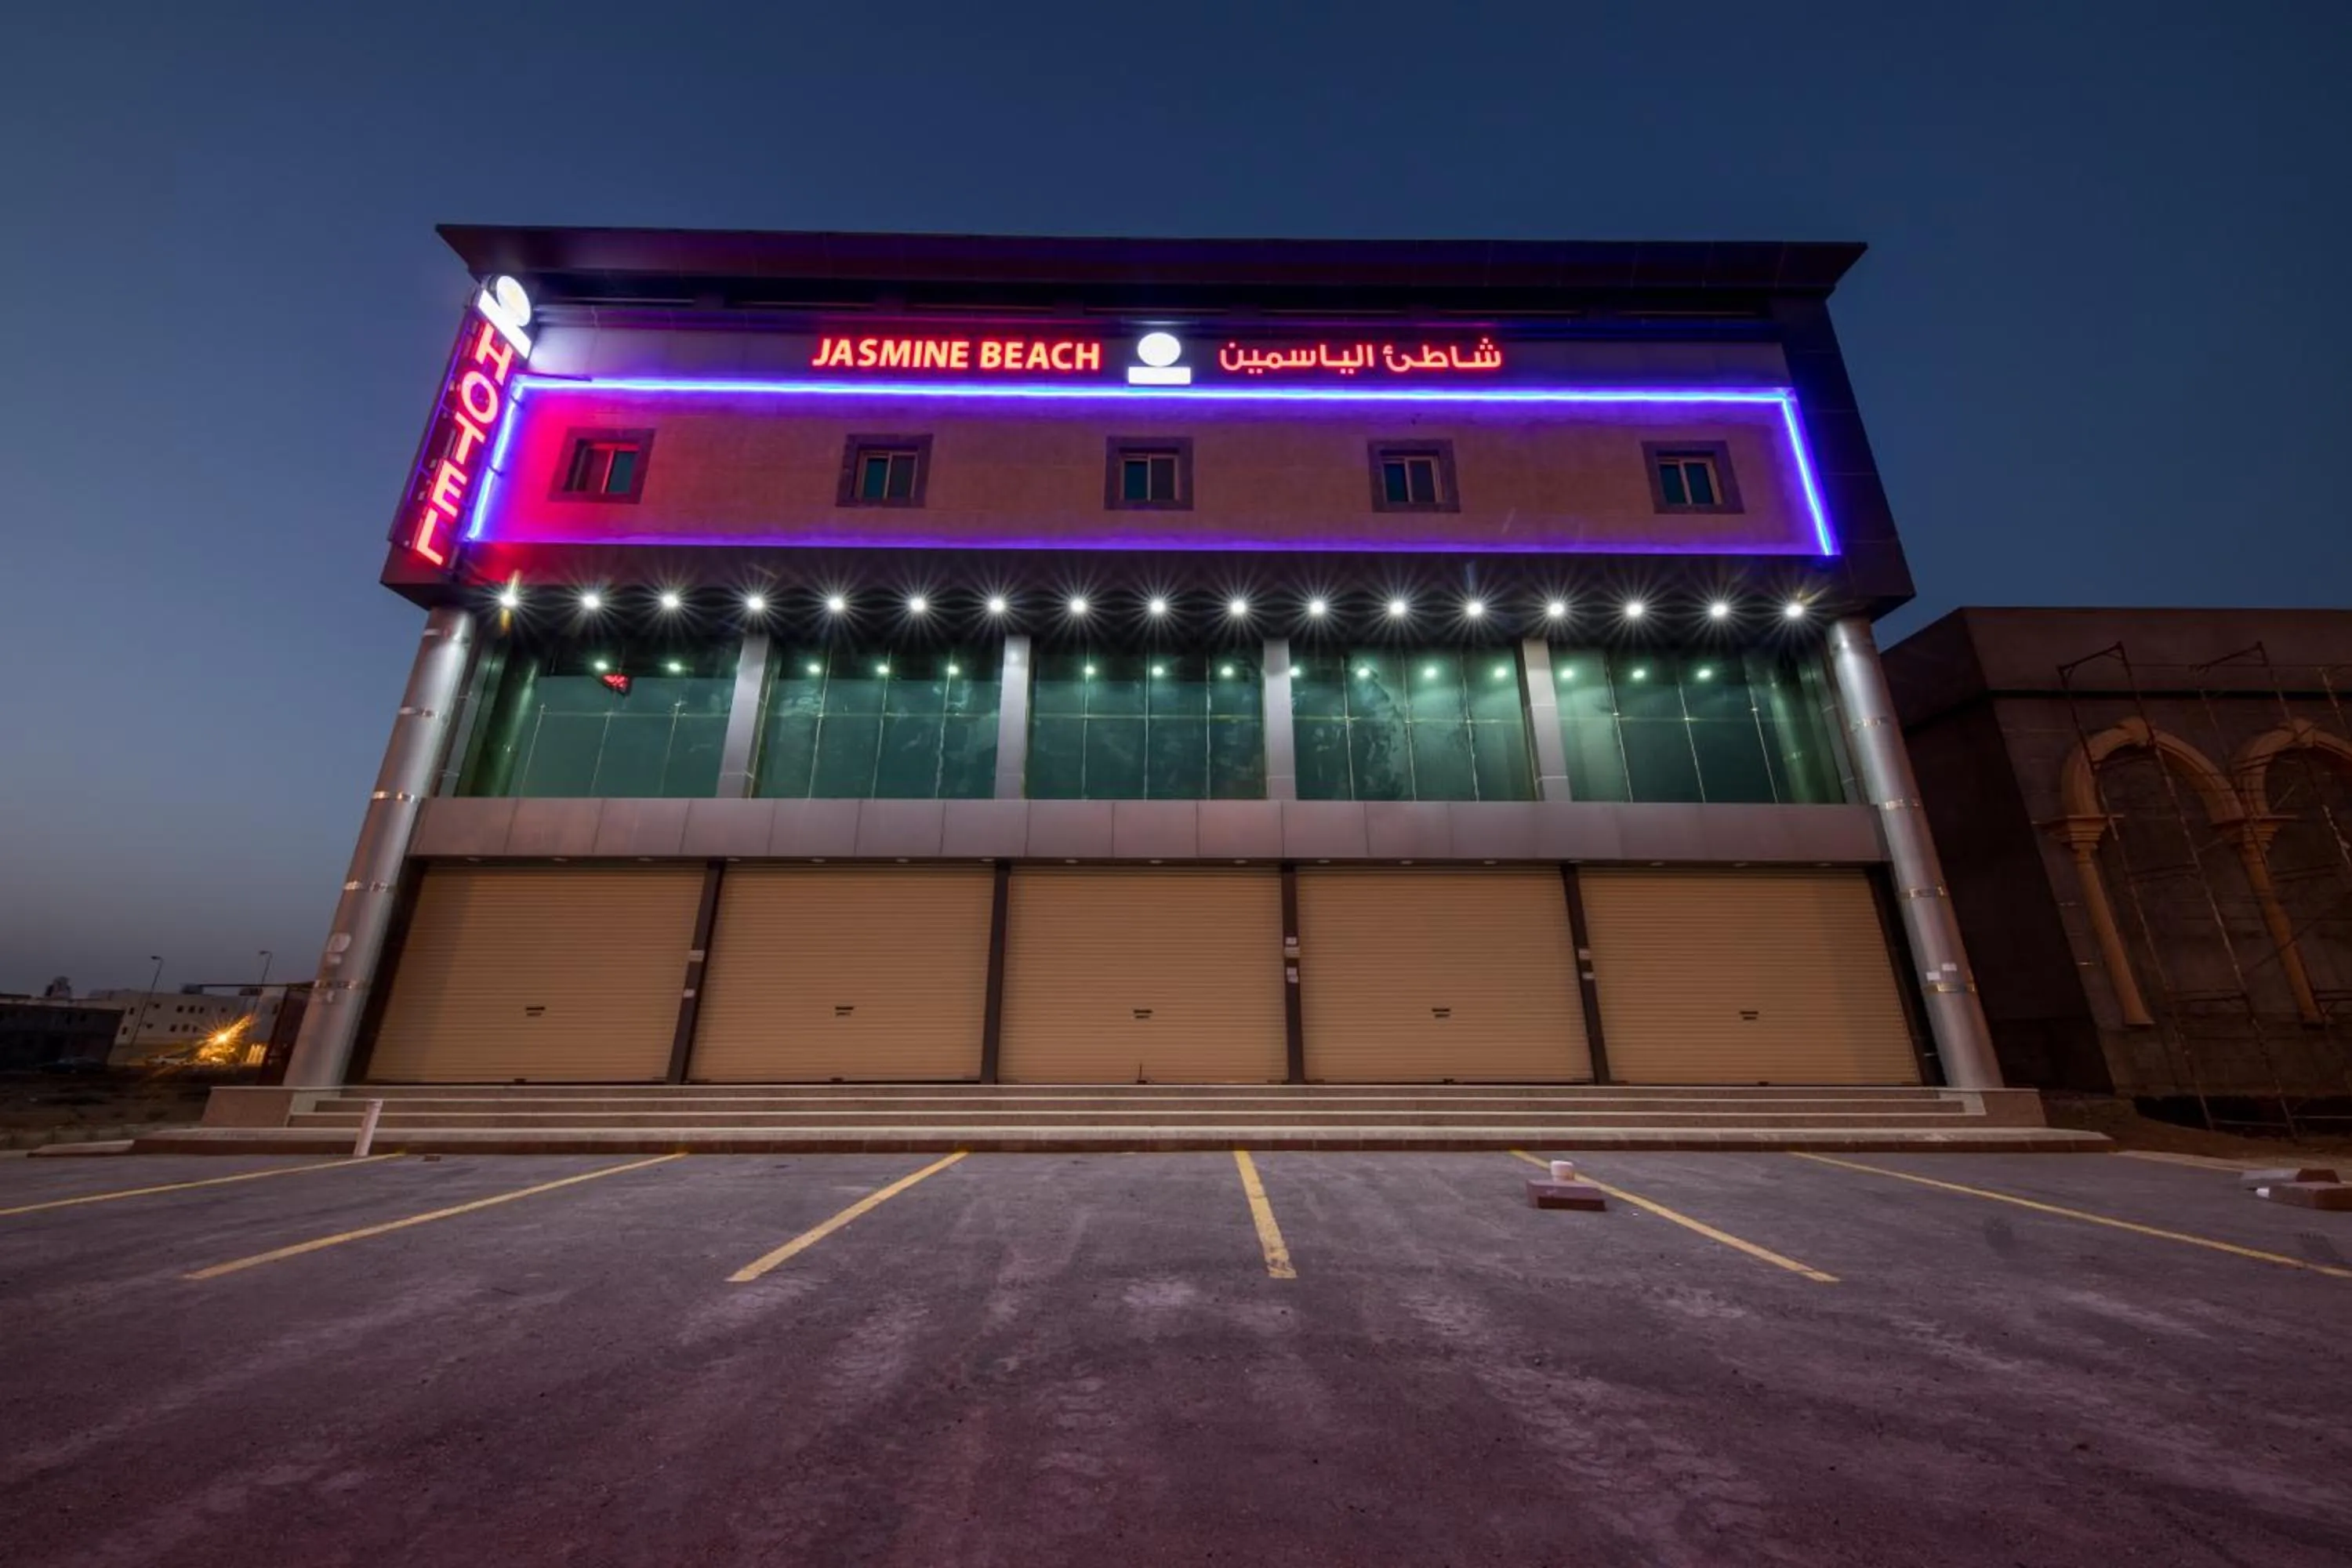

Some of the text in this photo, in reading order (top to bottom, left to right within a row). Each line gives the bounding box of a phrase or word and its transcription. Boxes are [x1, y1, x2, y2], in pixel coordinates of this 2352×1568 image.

[811, 337, 1100, 370] JASMINE BEACH
[1220, 337, 1502, 375] شاطئ الياسمين
[416, 321, 514, 566] HOTEL
